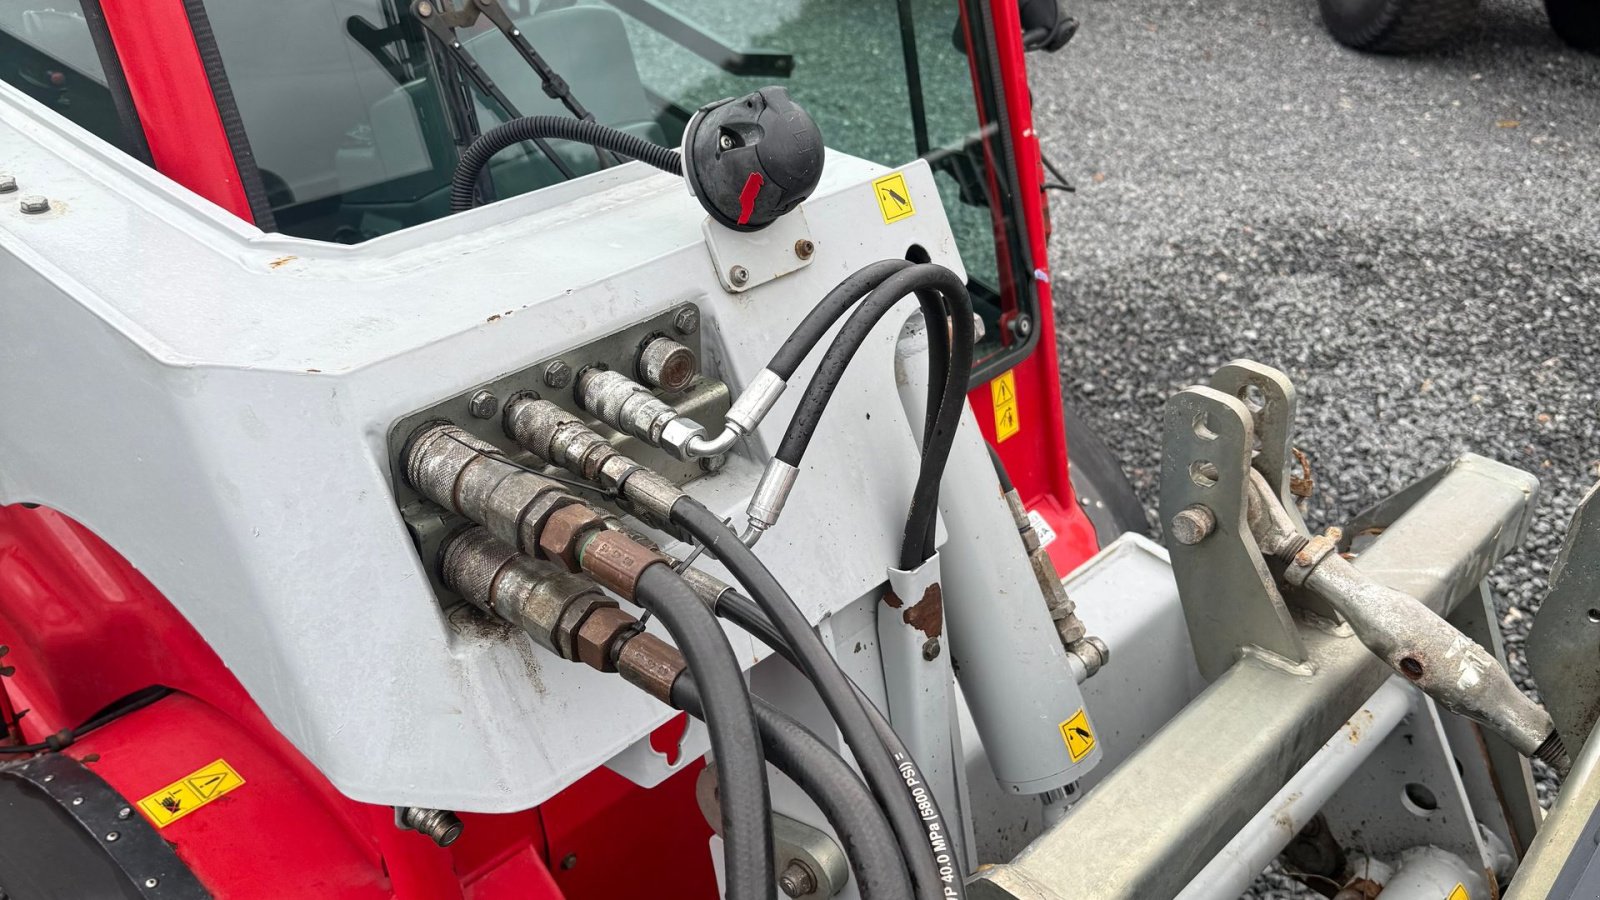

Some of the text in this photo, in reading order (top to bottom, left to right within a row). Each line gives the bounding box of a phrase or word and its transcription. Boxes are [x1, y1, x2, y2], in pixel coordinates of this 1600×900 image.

[899, 762, 920, 787] PSI)
[912, 788, 938, 820] (5800
[929, 822, 947, 853] MPa
[937, 854, 954, 883] 40.0
[944, 886, 959, 900] P
